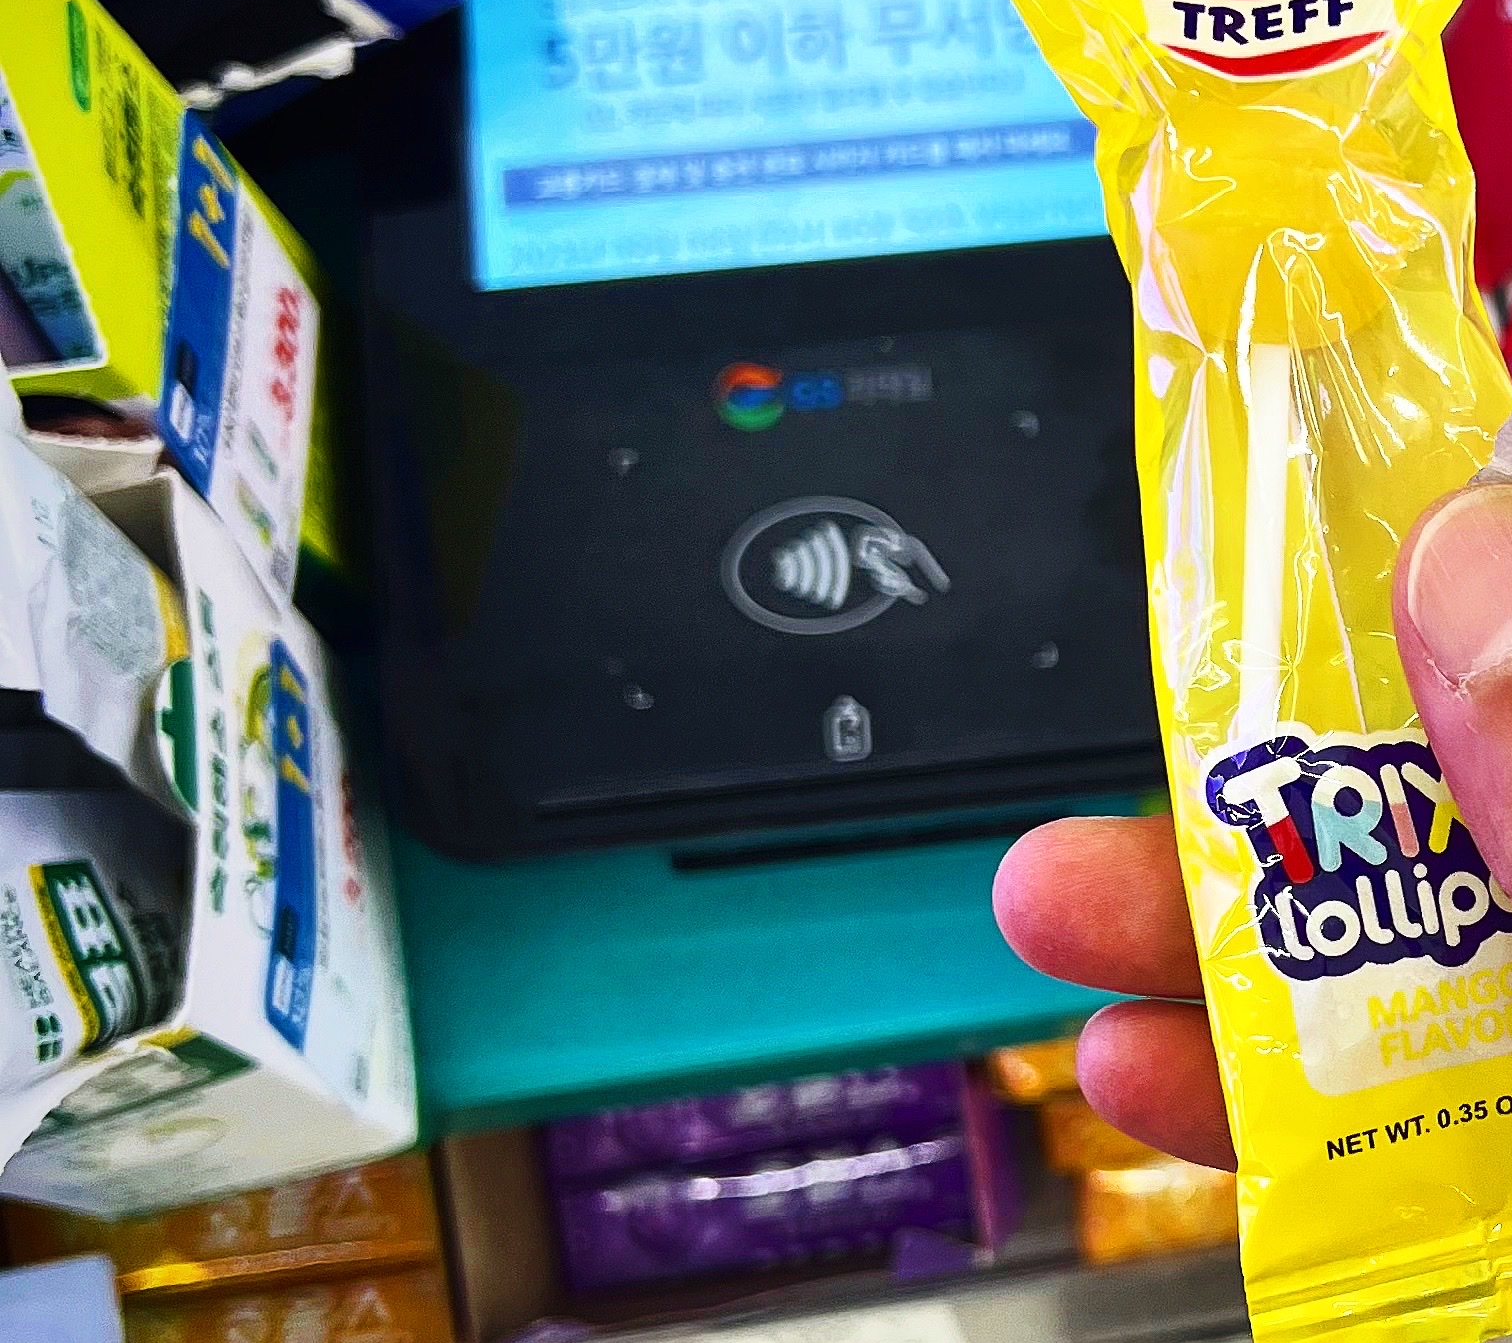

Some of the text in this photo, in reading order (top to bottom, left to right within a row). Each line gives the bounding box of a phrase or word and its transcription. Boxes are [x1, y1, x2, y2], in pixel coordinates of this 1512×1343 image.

[1326, 1128, 1379, 1162] NET
[1383, 1115, 1431, 1145] WT.
[1437, 1099, 1489, 1130] 0.35
